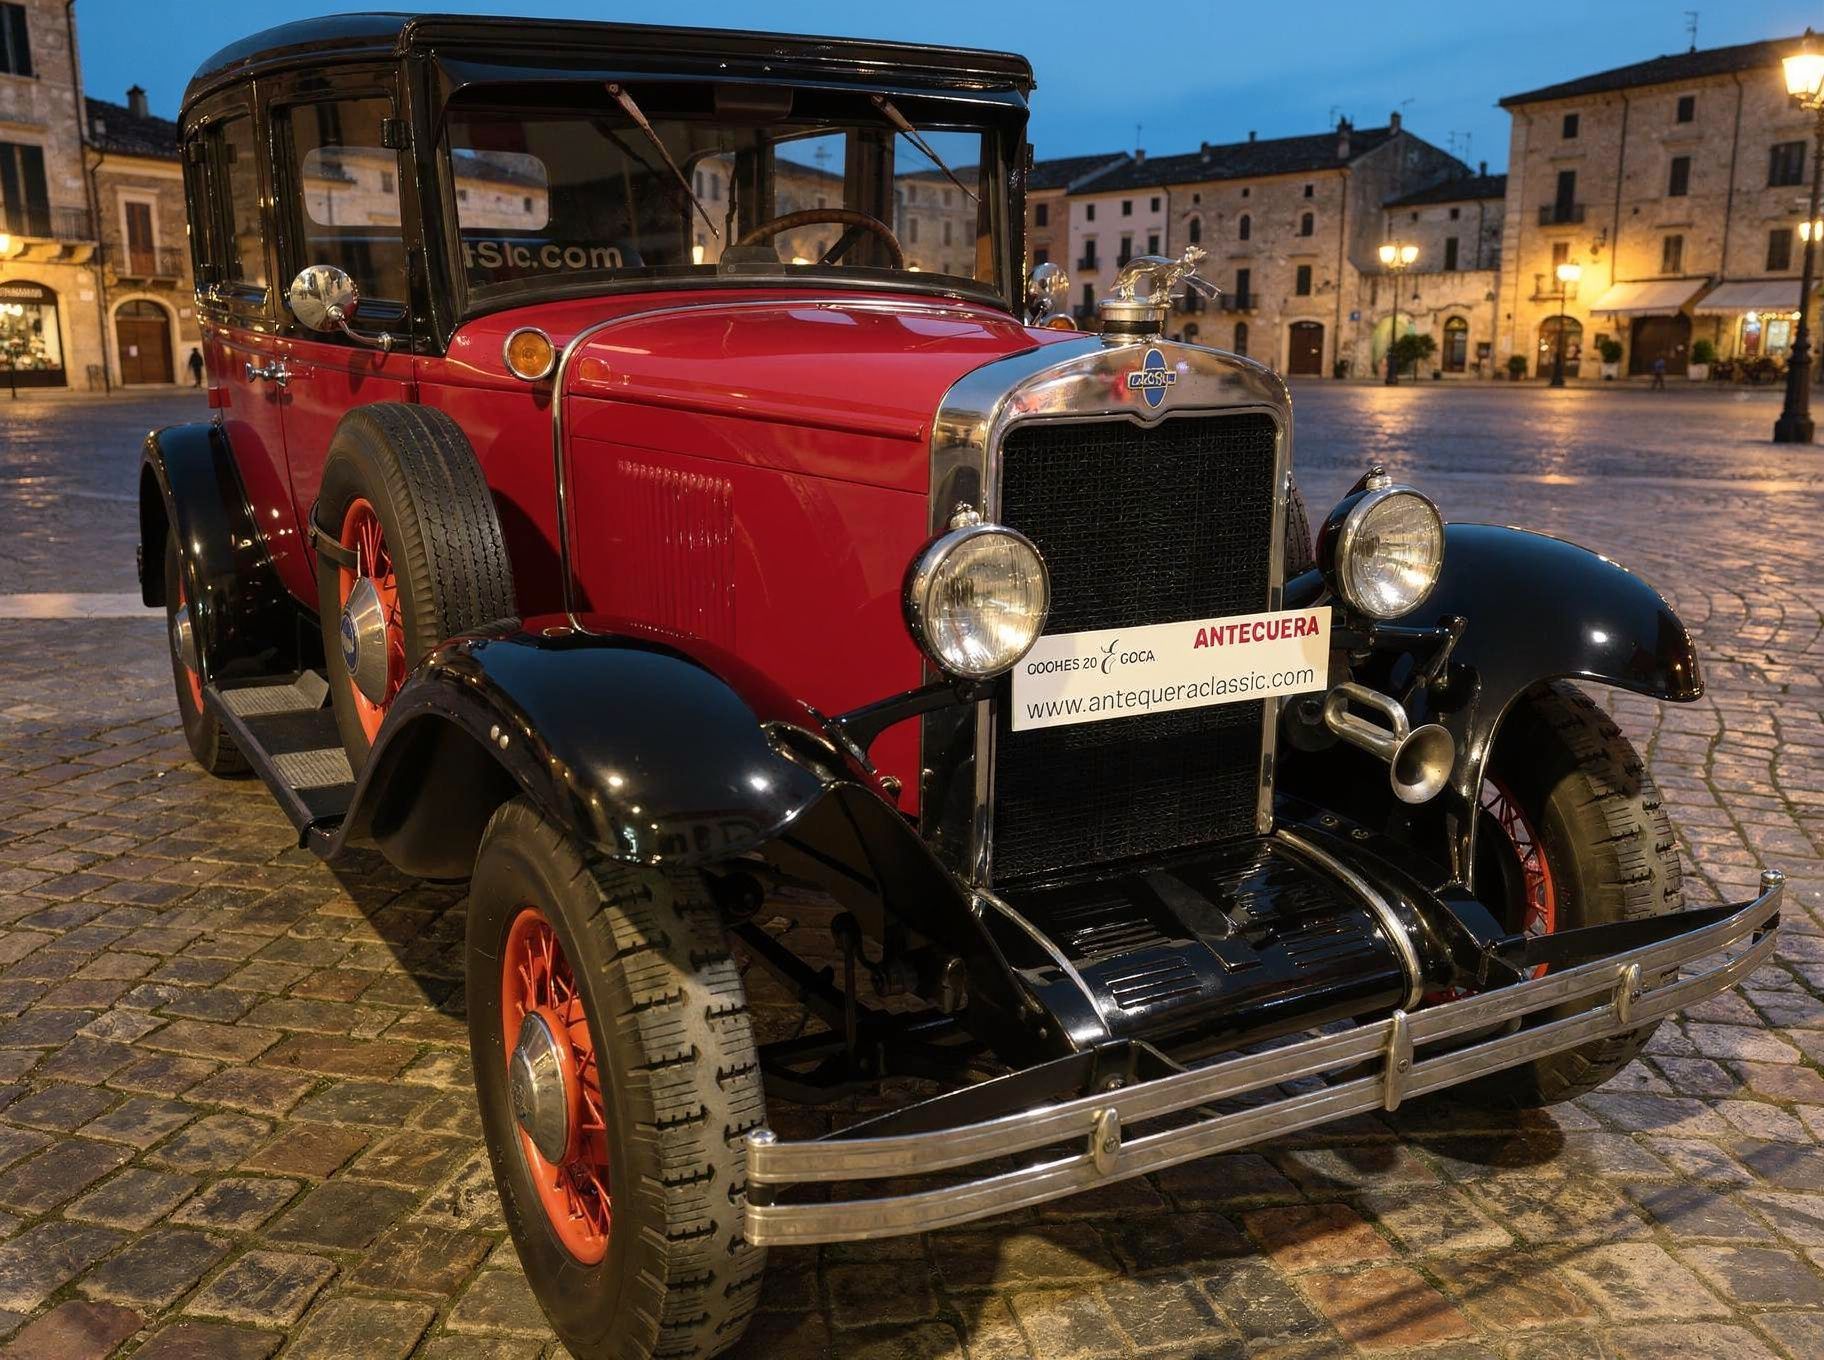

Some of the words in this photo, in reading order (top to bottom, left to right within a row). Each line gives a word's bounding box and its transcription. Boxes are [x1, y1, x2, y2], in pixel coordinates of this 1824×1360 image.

[1193, 615, 1320, 649] ANTECUERA
[1083, 656, 1098, 669] 20
[1120, 650, 1156, 665] GOCA
[1027, 667, 1314, 720] www.antequeraclassic.com
